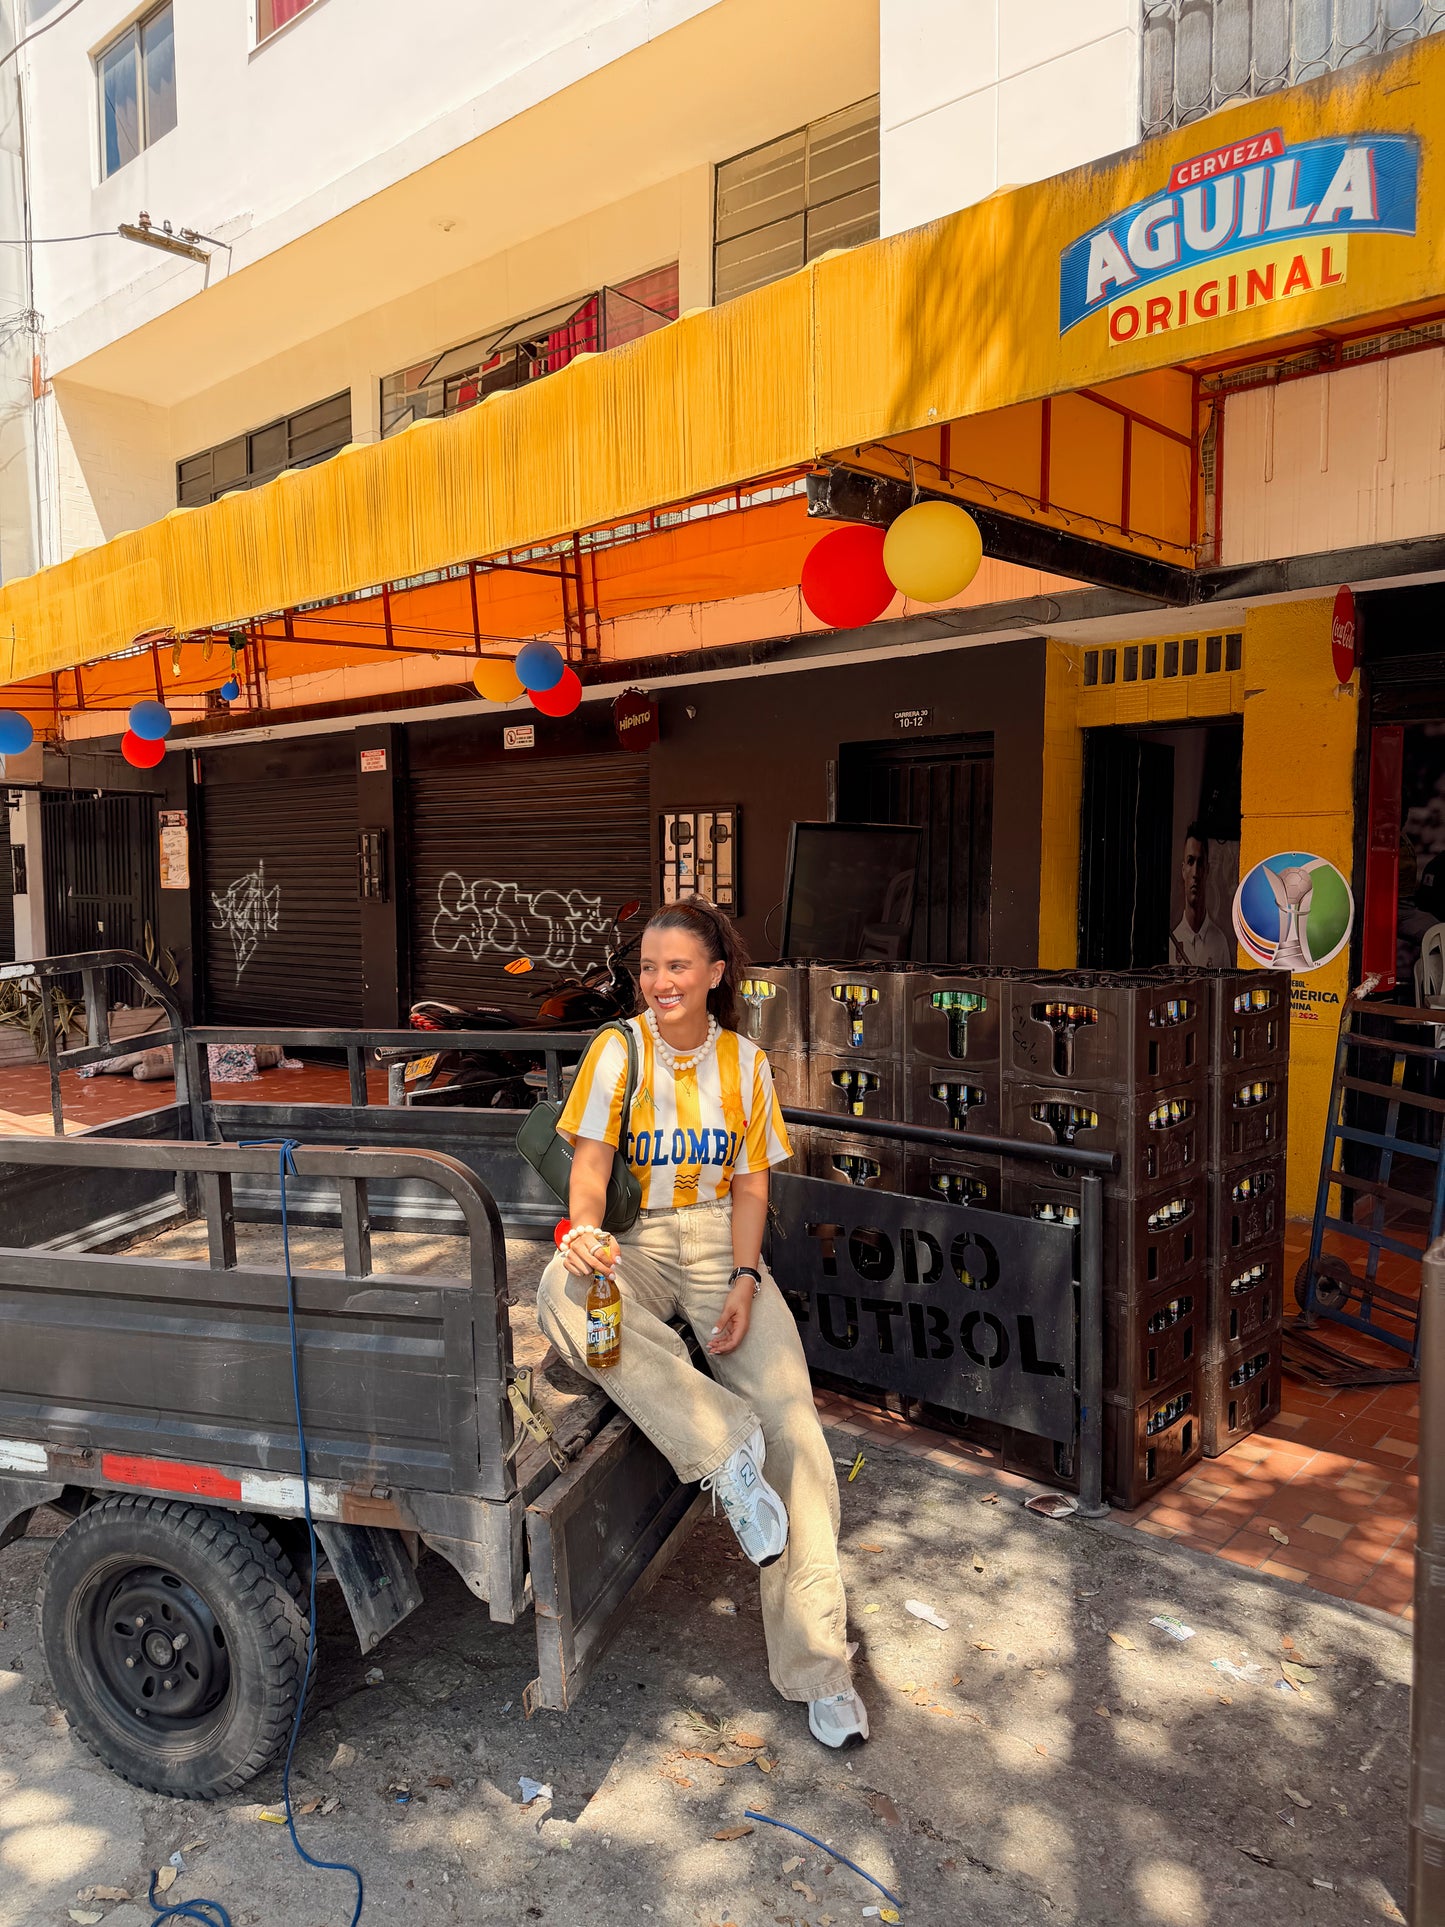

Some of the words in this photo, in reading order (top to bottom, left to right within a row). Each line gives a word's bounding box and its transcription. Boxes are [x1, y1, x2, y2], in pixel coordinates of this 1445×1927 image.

[1176, 137, 1274, 185] CERVEZA
[1085, 147, 1379, 306] AGUILA
[1109, 246, 1344, 342] ORIGINAL
[894, 711, 920, 719] CARRERA
[900, 717, 923, 728] 10-12
[1290, 989, 1339, 1004] MERICA
[1290, 1003, 1311, 1011] NINA
[807, 1222, 1001, 1291] TODO
